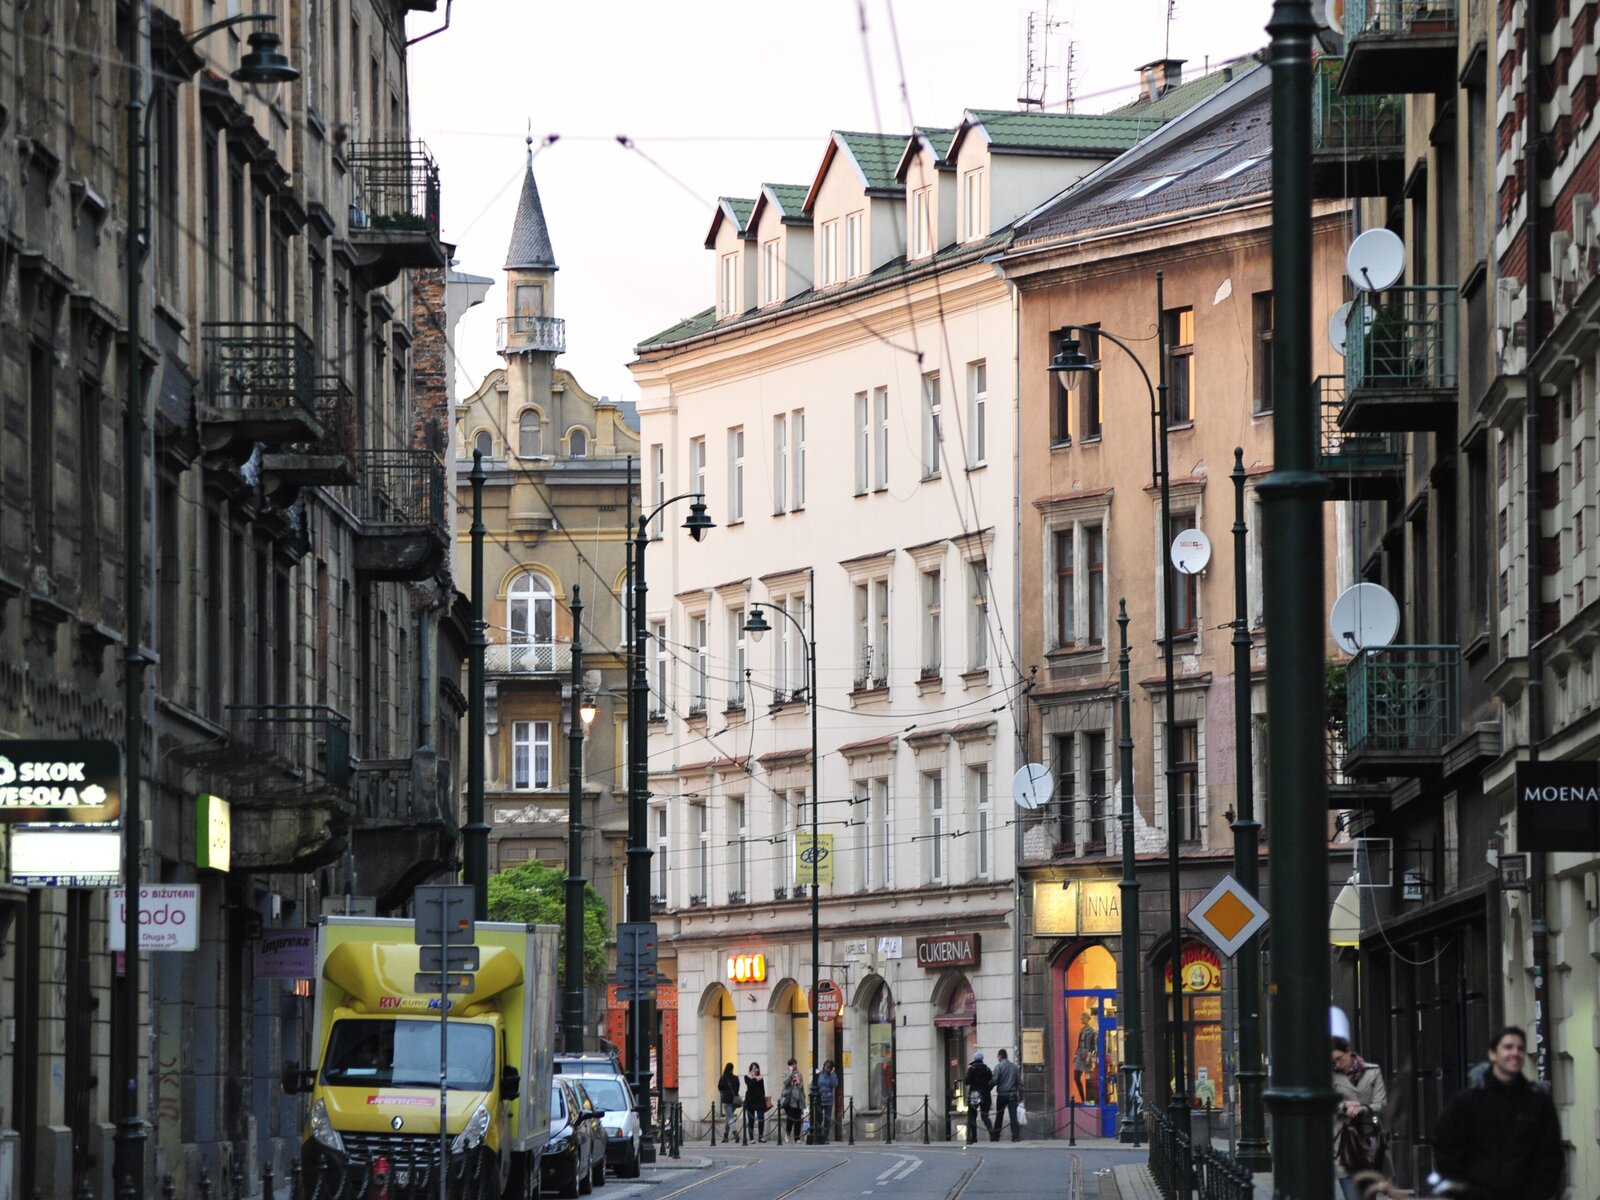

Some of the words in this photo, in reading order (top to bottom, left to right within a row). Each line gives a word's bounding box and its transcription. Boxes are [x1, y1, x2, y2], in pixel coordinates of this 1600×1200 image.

[19, 762, 86, 781] SKOK
[1524, 786, 1599, 801] MOENA
[113, 890, 148, 898] STO
[152, 888, 195, 899] BIŻUTERII
[1085, 895, 1120, 917] INNA
[918, 940, 972, 963] CUKIERNIA
[380, 997, 402, 1009] RTV
[818, 1003, 839, 1011] ZAPKI
